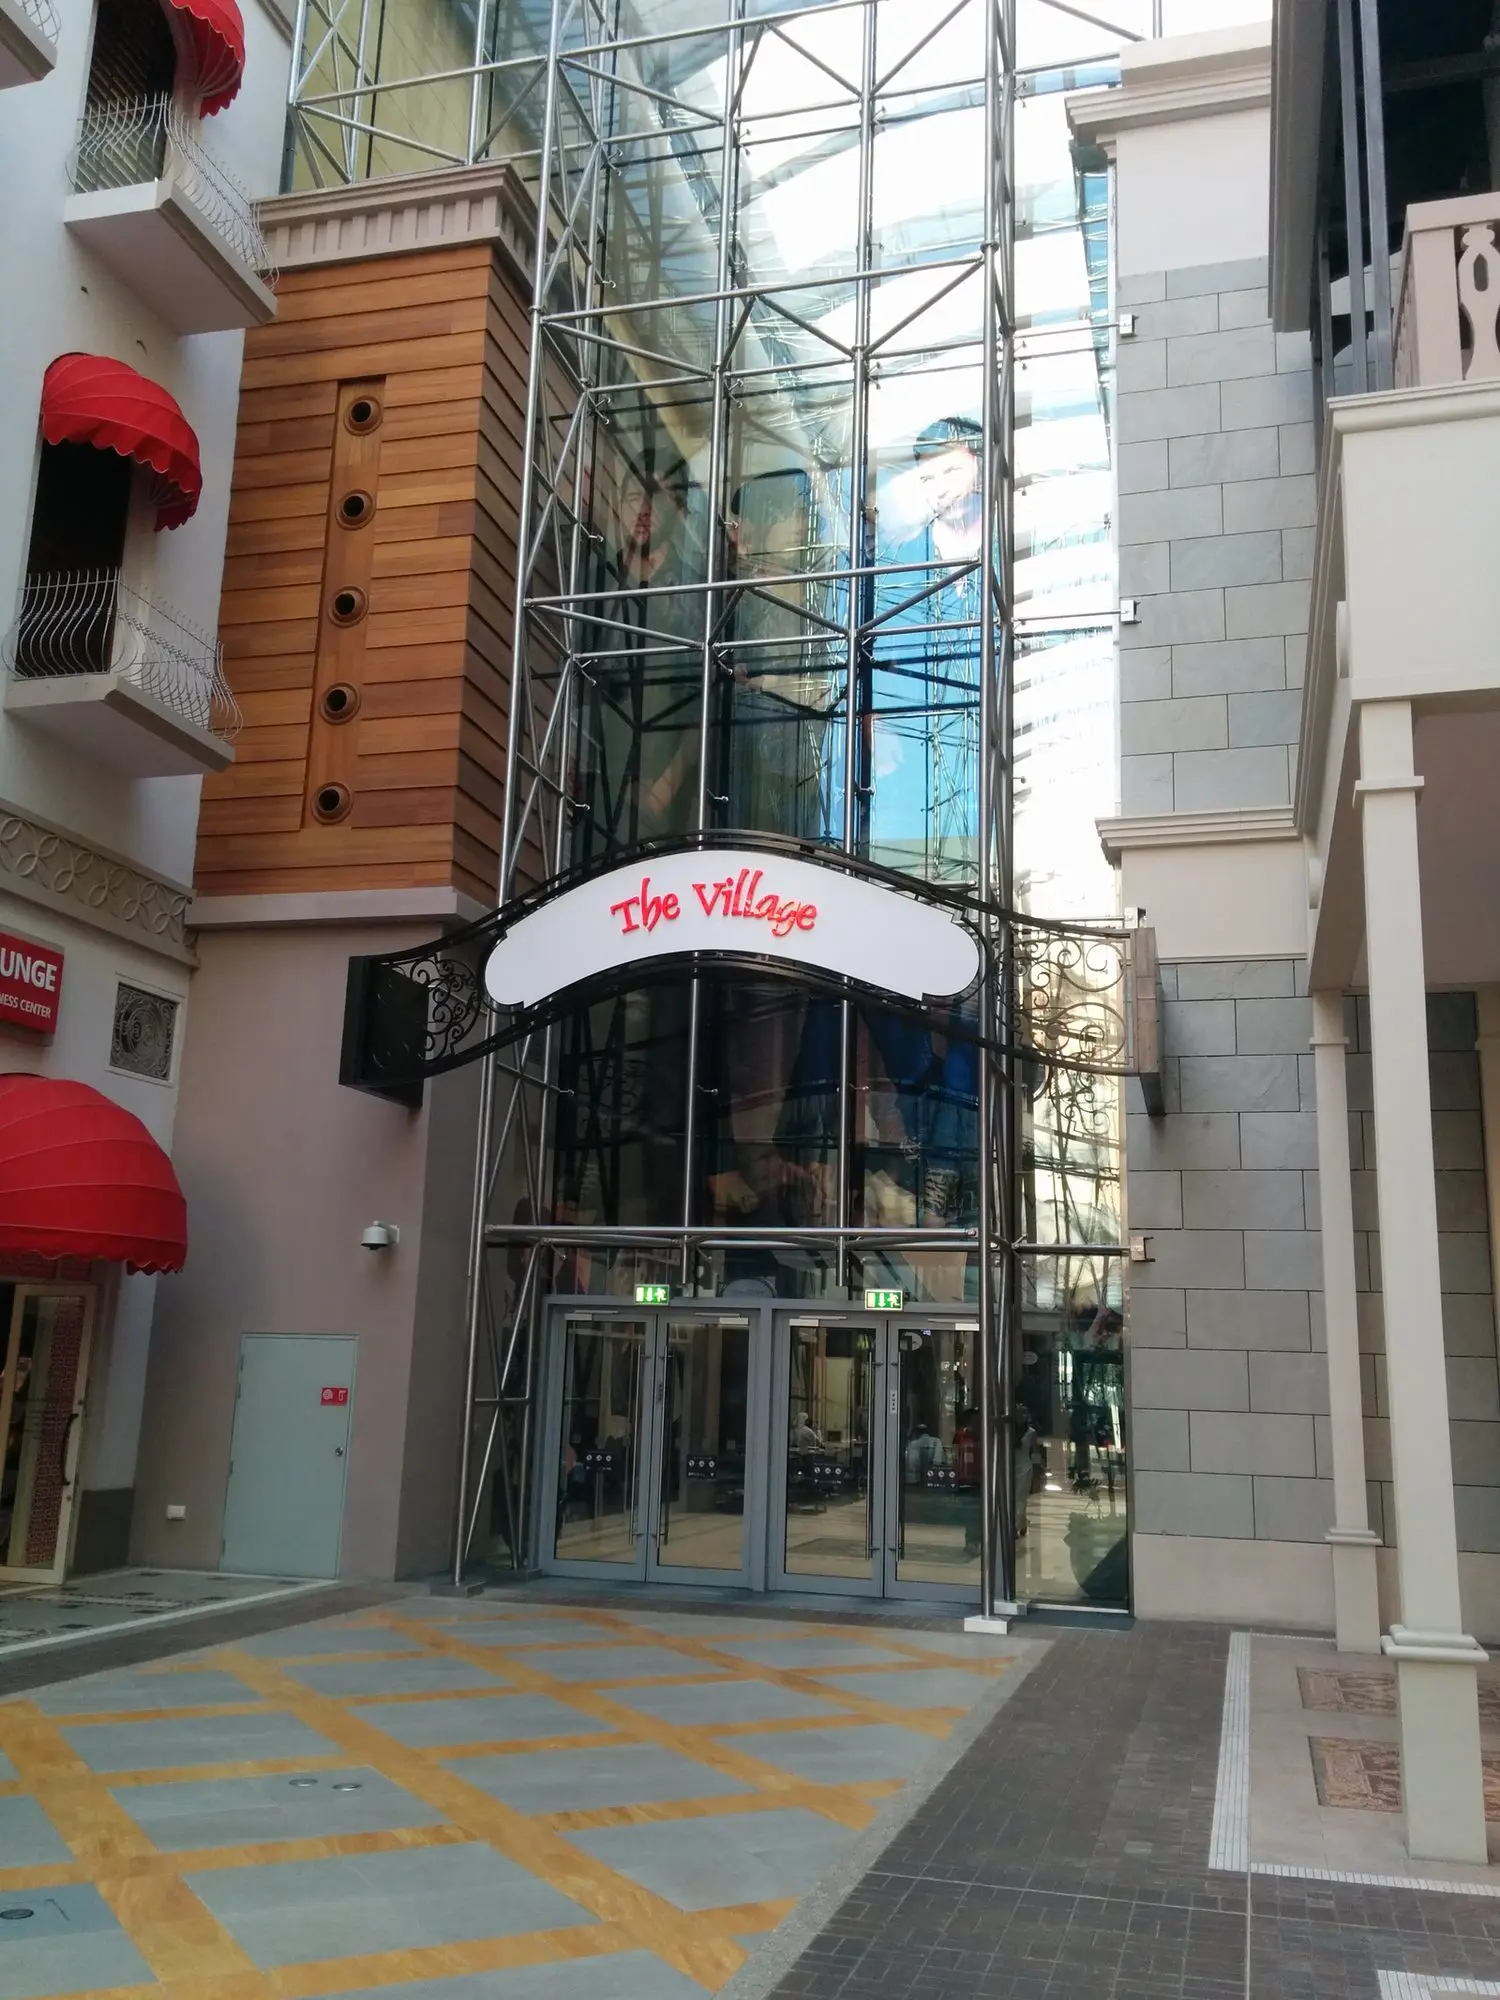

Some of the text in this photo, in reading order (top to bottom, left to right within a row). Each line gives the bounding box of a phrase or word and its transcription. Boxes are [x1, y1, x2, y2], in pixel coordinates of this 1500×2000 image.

[611, 868, 818, 937] The Village
[19, 998, 51, 1018] CENTER
